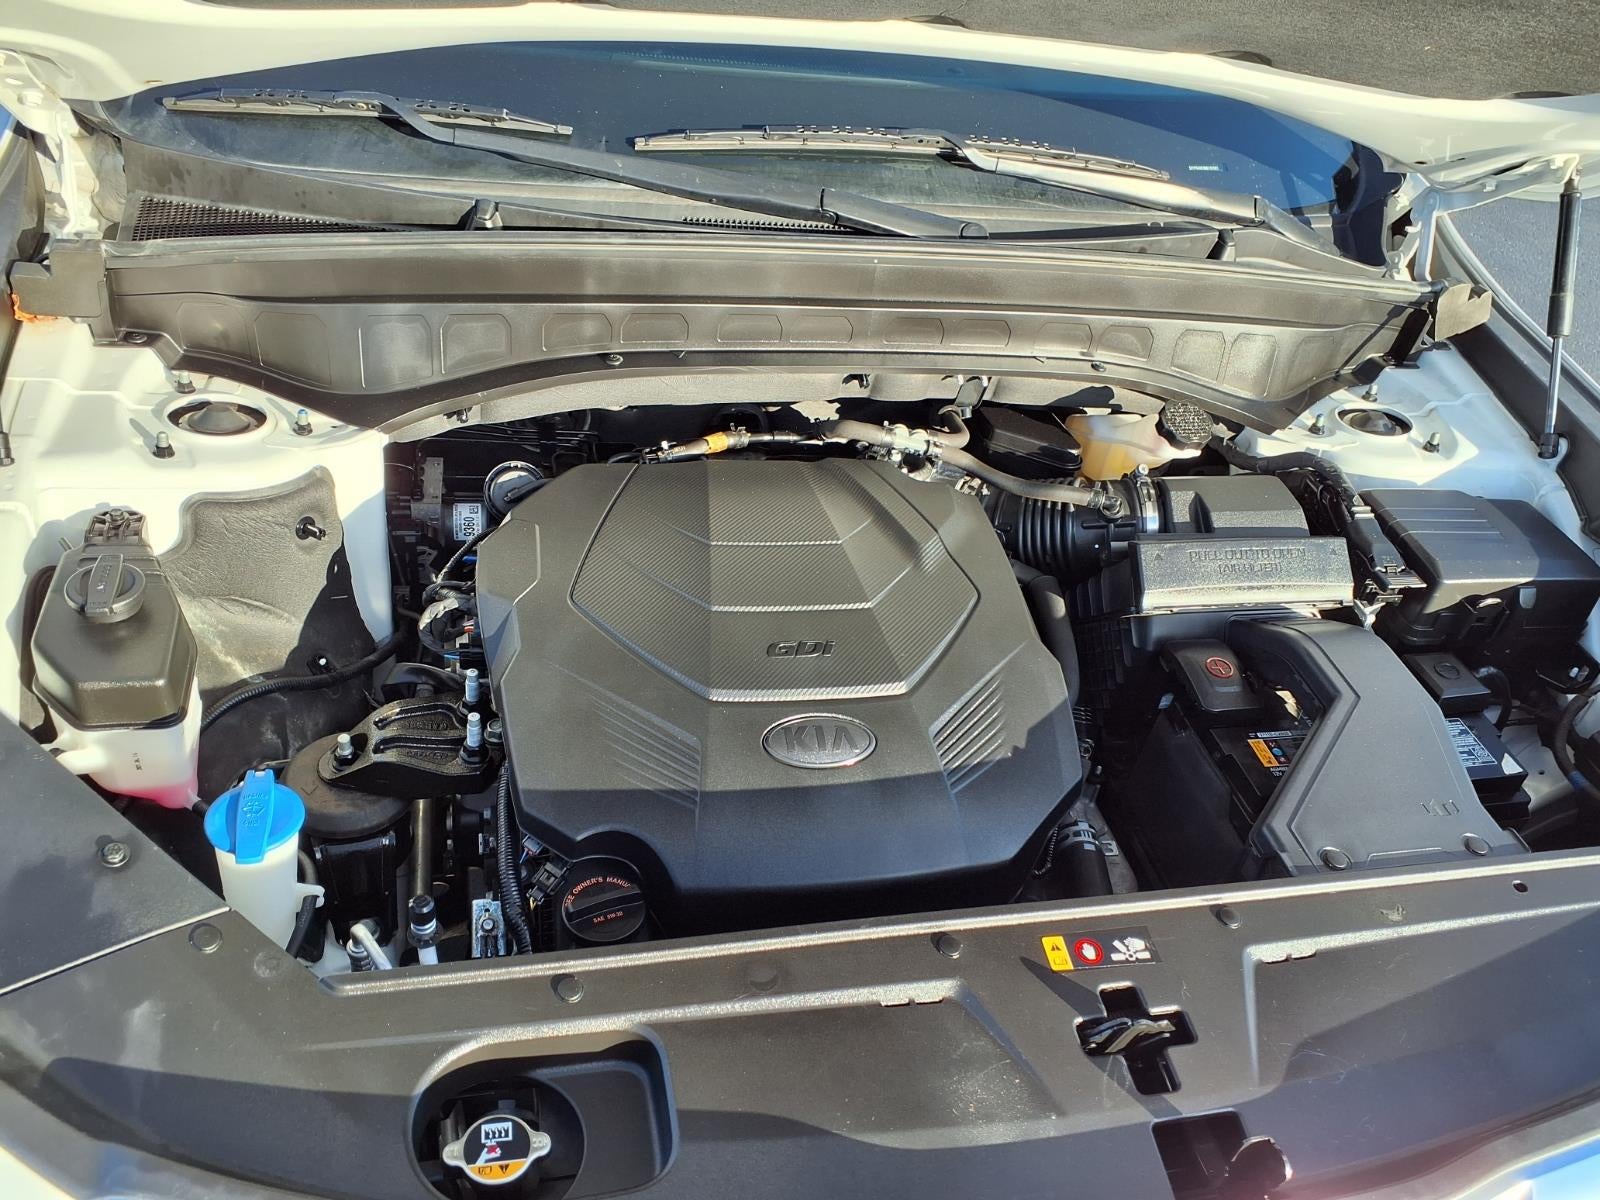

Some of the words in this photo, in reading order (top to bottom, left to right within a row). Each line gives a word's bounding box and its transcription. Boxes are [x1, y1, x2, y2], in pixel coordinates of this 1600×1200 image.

[463, 516, 475, 537] 9360
[1189, 549, 1223, 562] PULL
[1225, 548, 1251, 560] OUT
[1272, 546, 1306, 560] OPEN
[782, 725, 860, 752] KIA
[572, 876, 604, 894] OWNER'S
[606, 876, 631, 888] MANU
[593, 915, 605, 923] SAE
